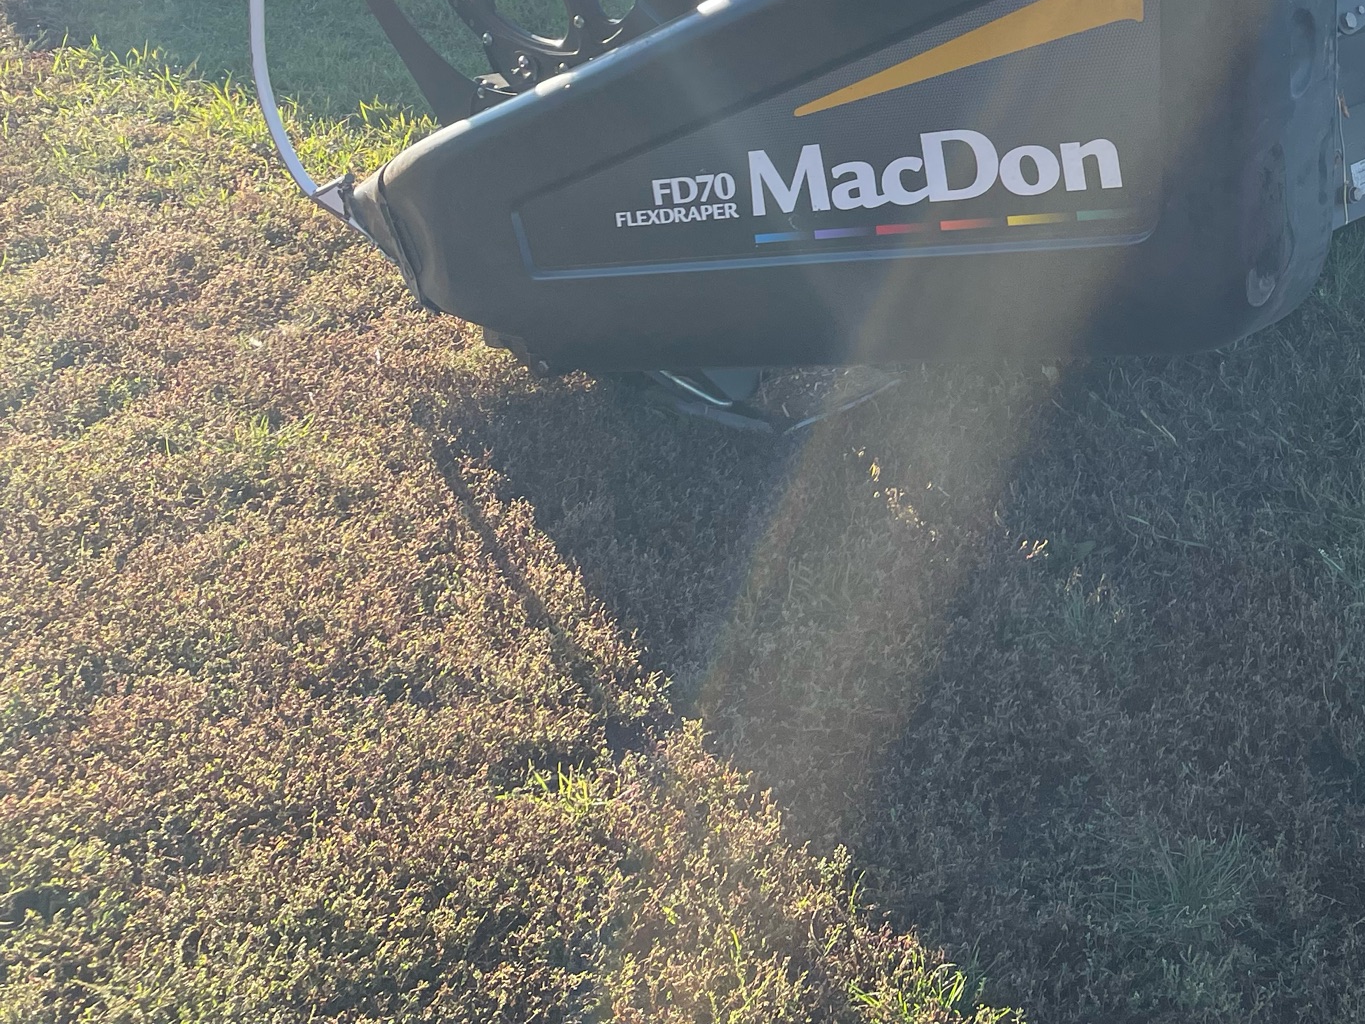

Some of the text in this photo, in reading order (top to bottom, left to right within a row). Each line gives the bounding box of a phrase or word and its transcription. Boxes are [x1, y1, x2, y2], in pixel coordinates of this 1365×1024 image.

[652, 172, 736, 206] FD70
[747, 129, 1123, 217] MacDon
[615, 202, 740, 228] FLEXDRAPER
